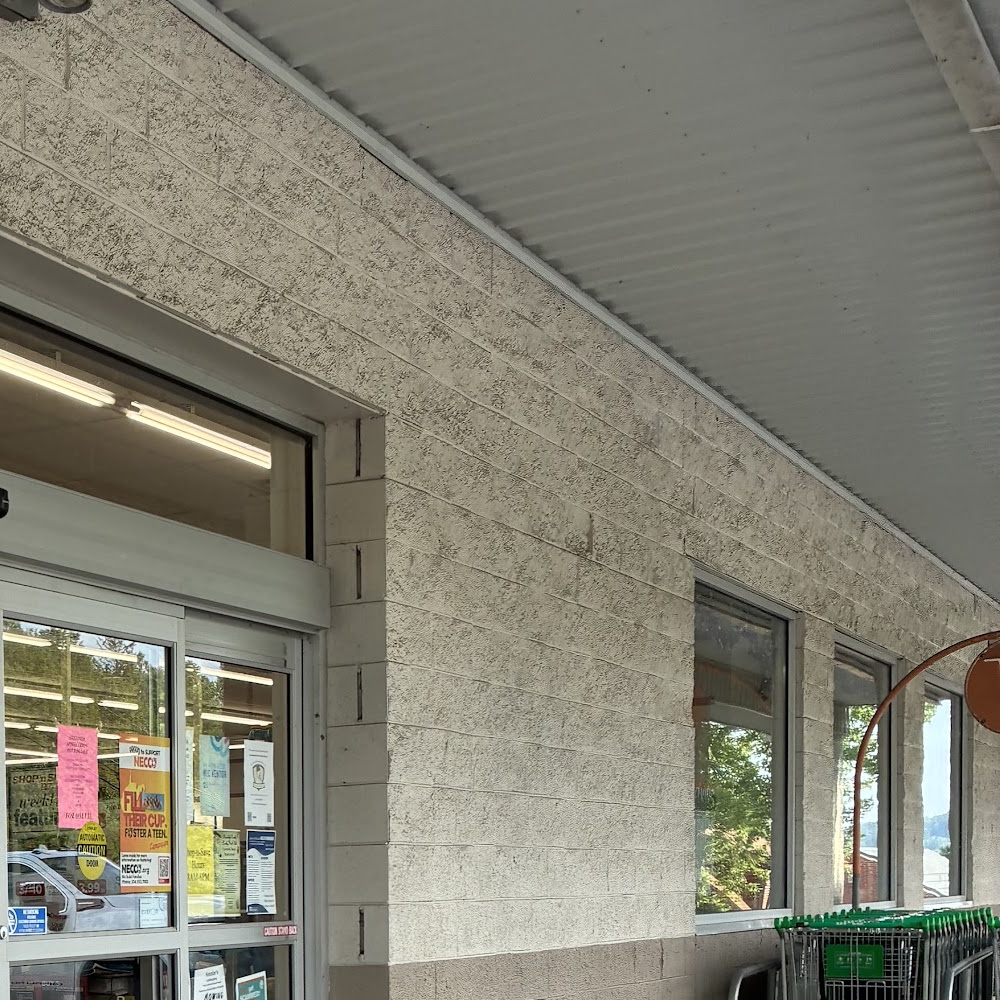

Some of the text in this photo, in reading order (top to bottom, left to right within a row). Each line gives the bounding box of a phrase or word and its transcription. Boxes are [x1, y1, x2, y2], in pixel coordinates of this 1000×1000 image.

[12, 774, 38, 785] SHOP
[19, 793, 55, 809] weekl
[123, 813, 168, 828] THEIR CUP.
[80, 833, 105, 841] AUTOMATIC
[124, 828, 167, 839] FOSTER A TEEN.
[78, 845, 106, 856] CAUTION
[86, 859, 99, 867] DOOR
[264, 927, 277, 936] CAUTION
[288, 926, 298, 935] BACK
